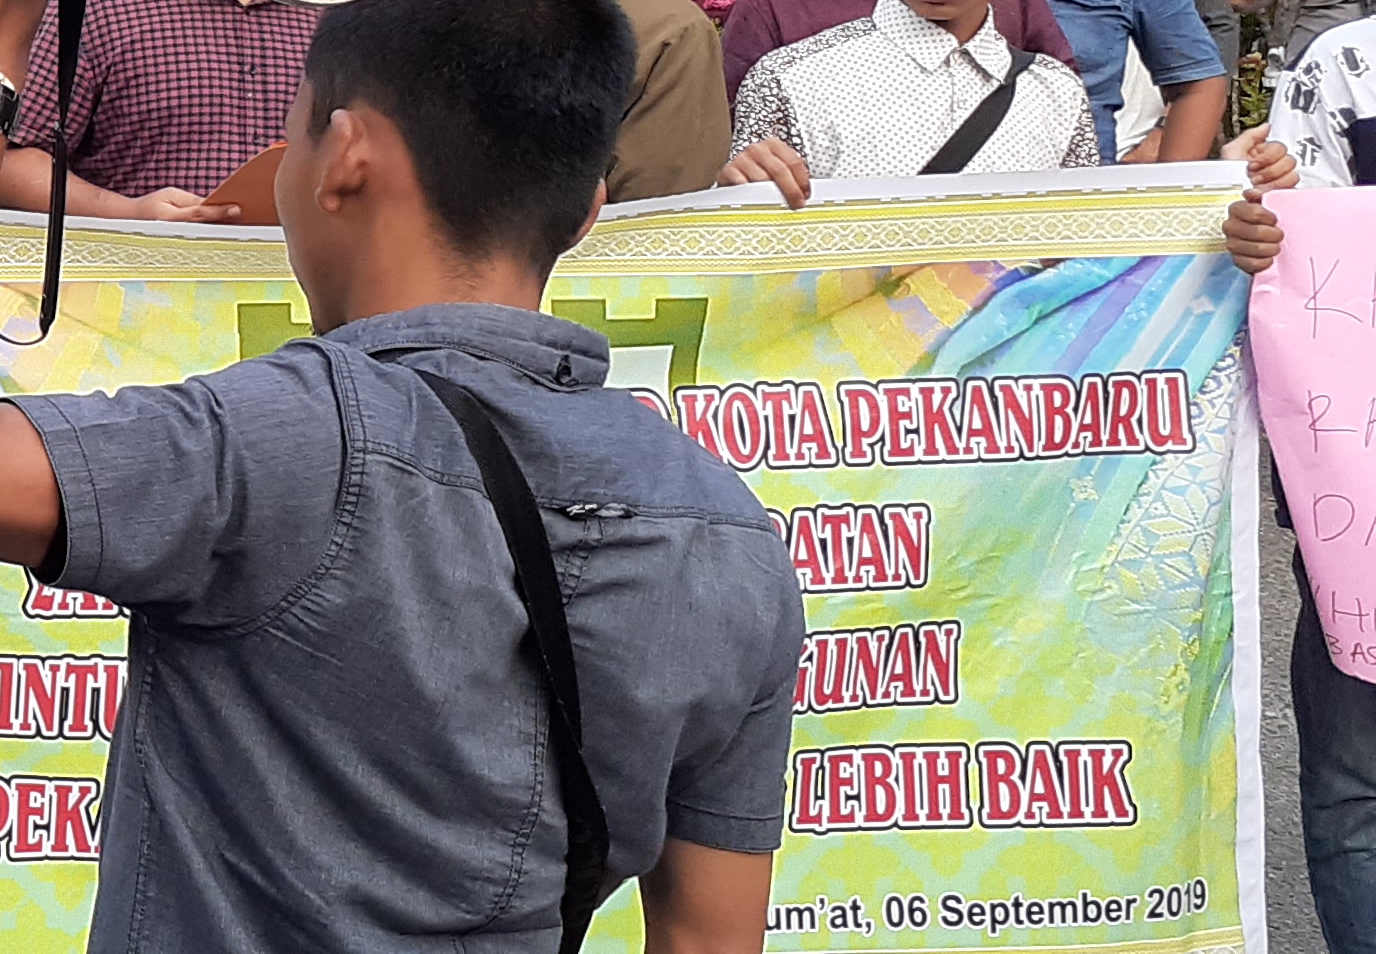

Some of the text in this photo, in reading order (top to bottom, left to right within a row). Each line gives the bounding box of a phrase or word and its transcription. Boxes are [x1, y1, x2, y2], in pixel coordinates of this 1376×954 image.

[675, 383, 839, 469] KOTA
[838, 374, 1192, 468] PEKANBARU
[784, 503, 930, 593] ATAN
[793, 621, 959, 713] UNAN
[790, 743, 972, 834] LEBIH
[975, 740, 1137, 828] BAIK
[765, 878, 1208, 936] um'at, 06 September 2019
